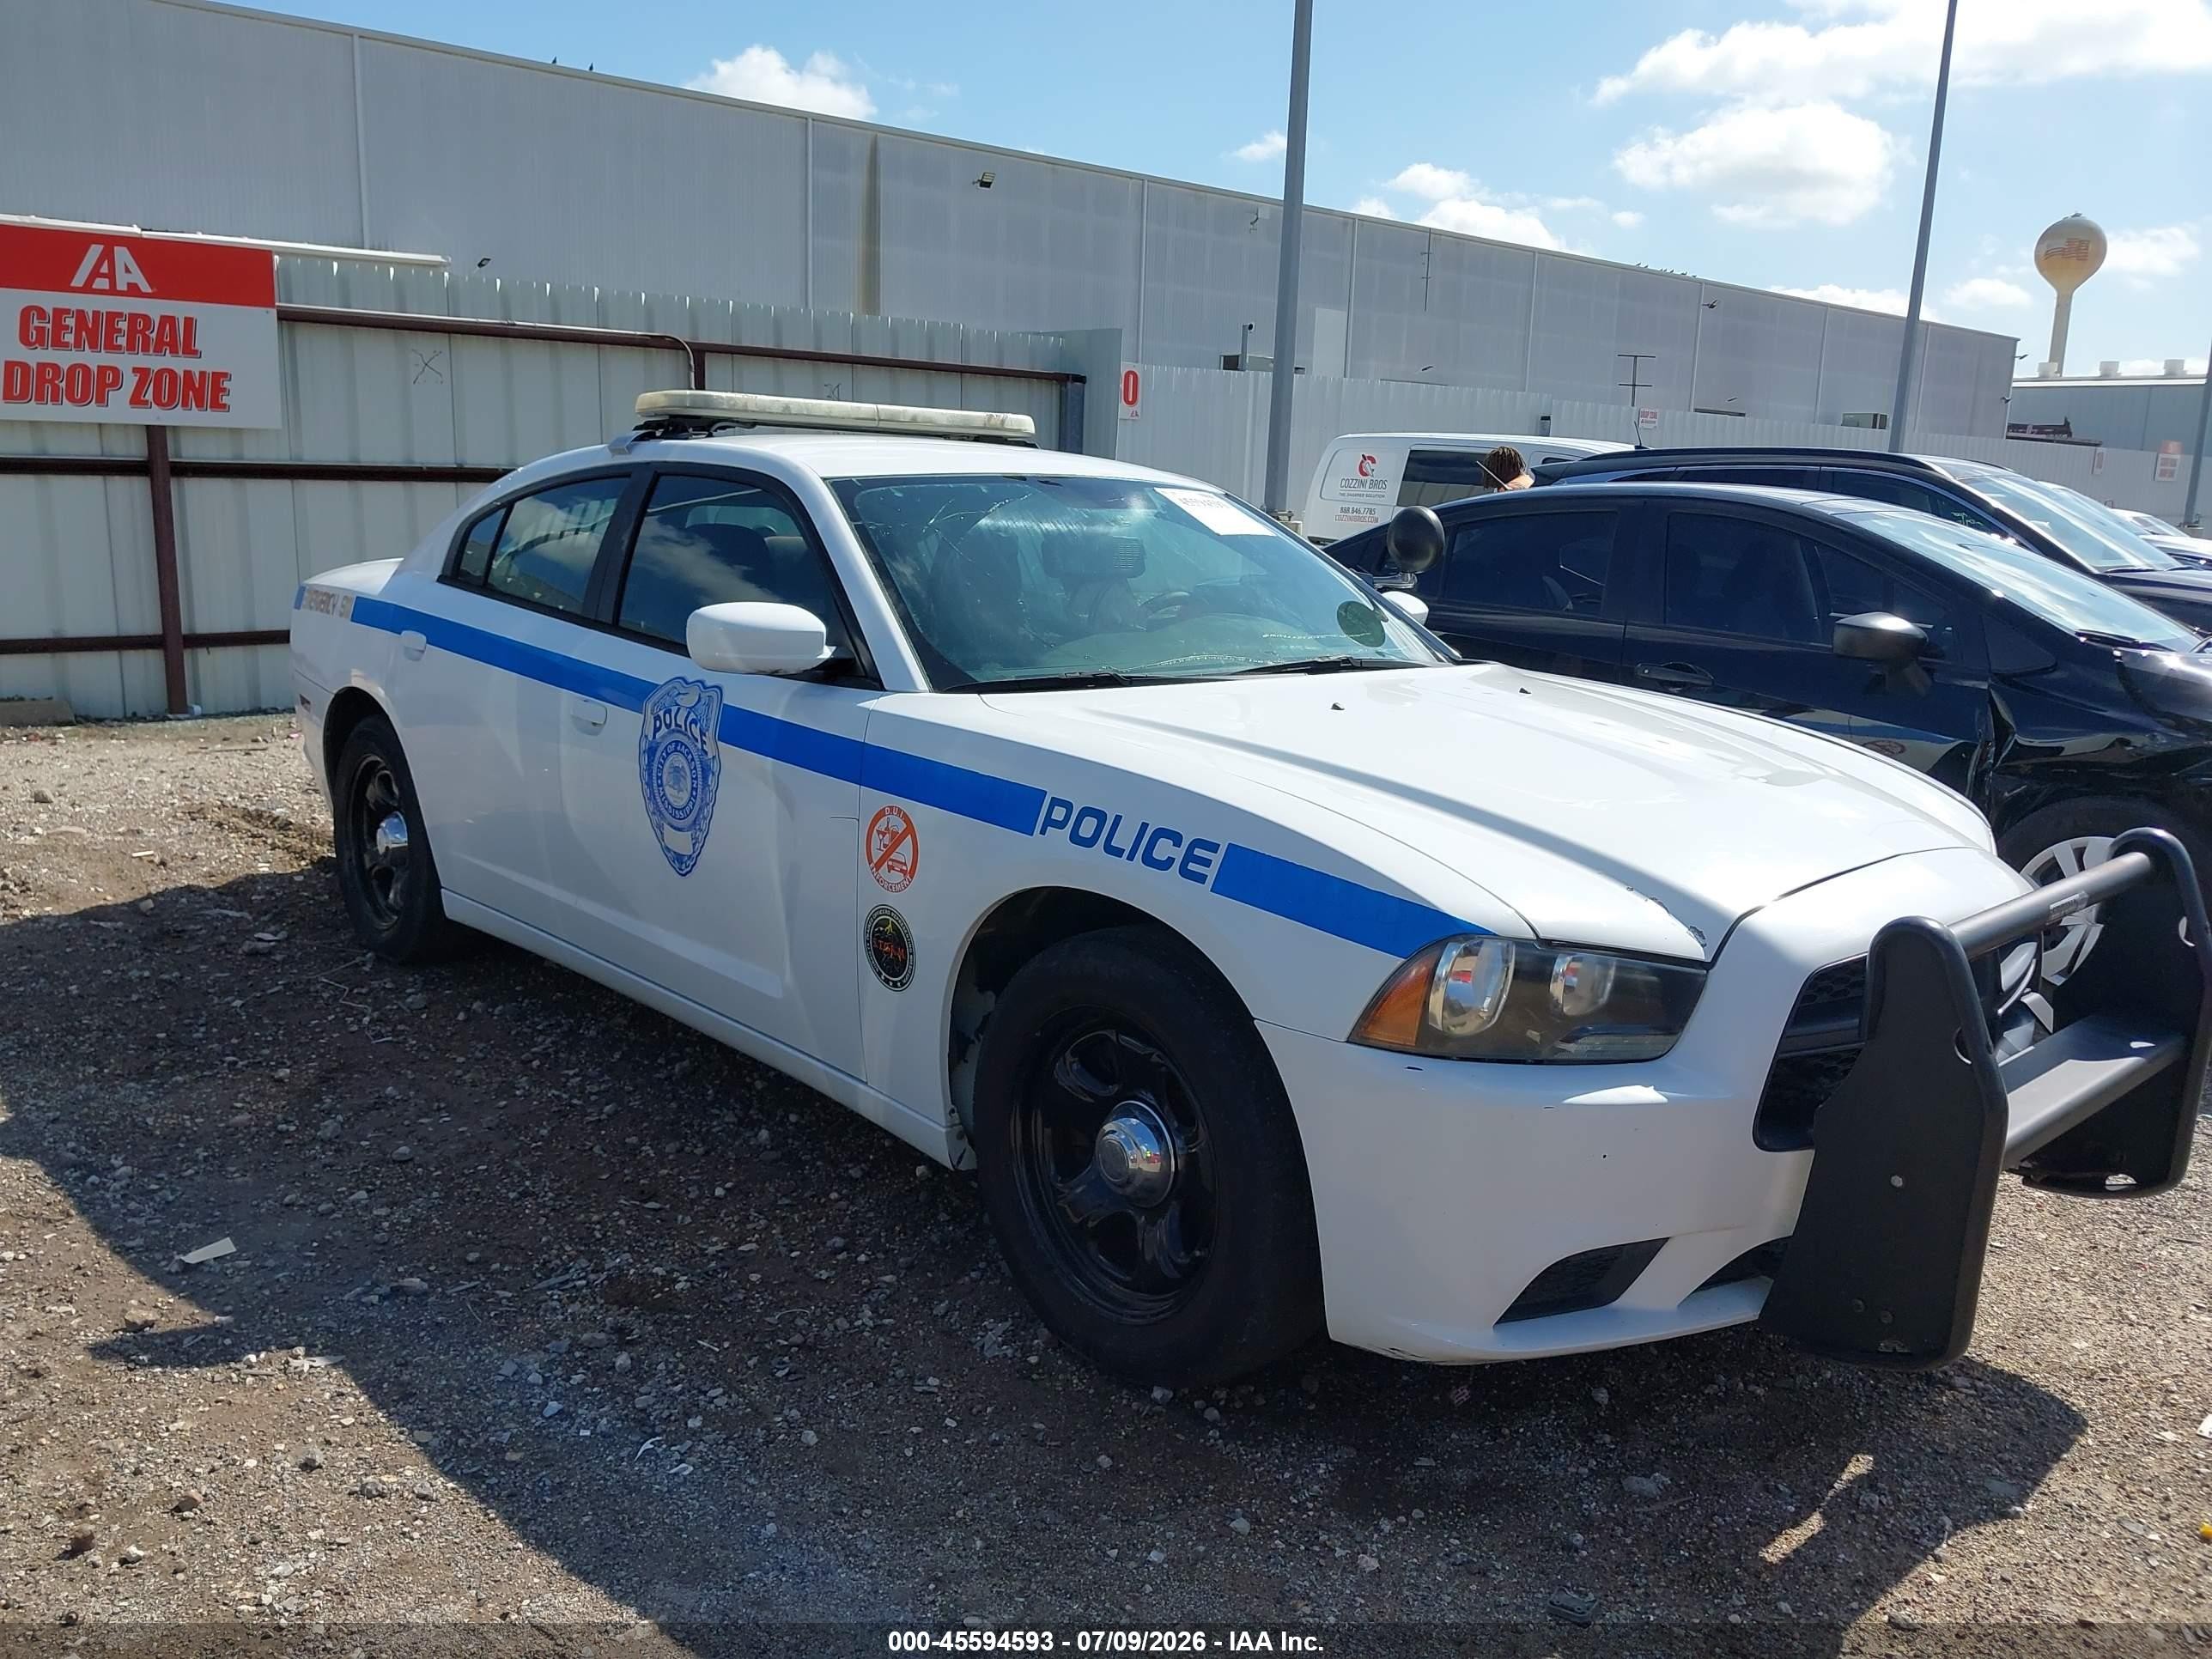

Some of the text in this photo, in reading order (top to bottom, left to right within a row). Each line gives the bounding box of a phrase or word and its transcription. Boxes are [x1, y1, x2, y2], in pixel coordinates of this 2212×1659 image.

[18, 305, 202, 359] GENERAL
[2, 360, 232, 413] DROP ZONE
[1340, 477, 1388, 490] COZZINI BROS
[1340, 506, 1376, 516] 888.846.7785
[652, 708, 709, 757] POLICE
[658, 742, 698, 788] CITY OF JACKSON
[658, 787, 696, 819] MISSISSIPPI
[884, 807, 905, 821] D.U.I.
[1039, 796, 1221, 885] POLICE
[870, 862, 913, 892] ENFORCEMENT
